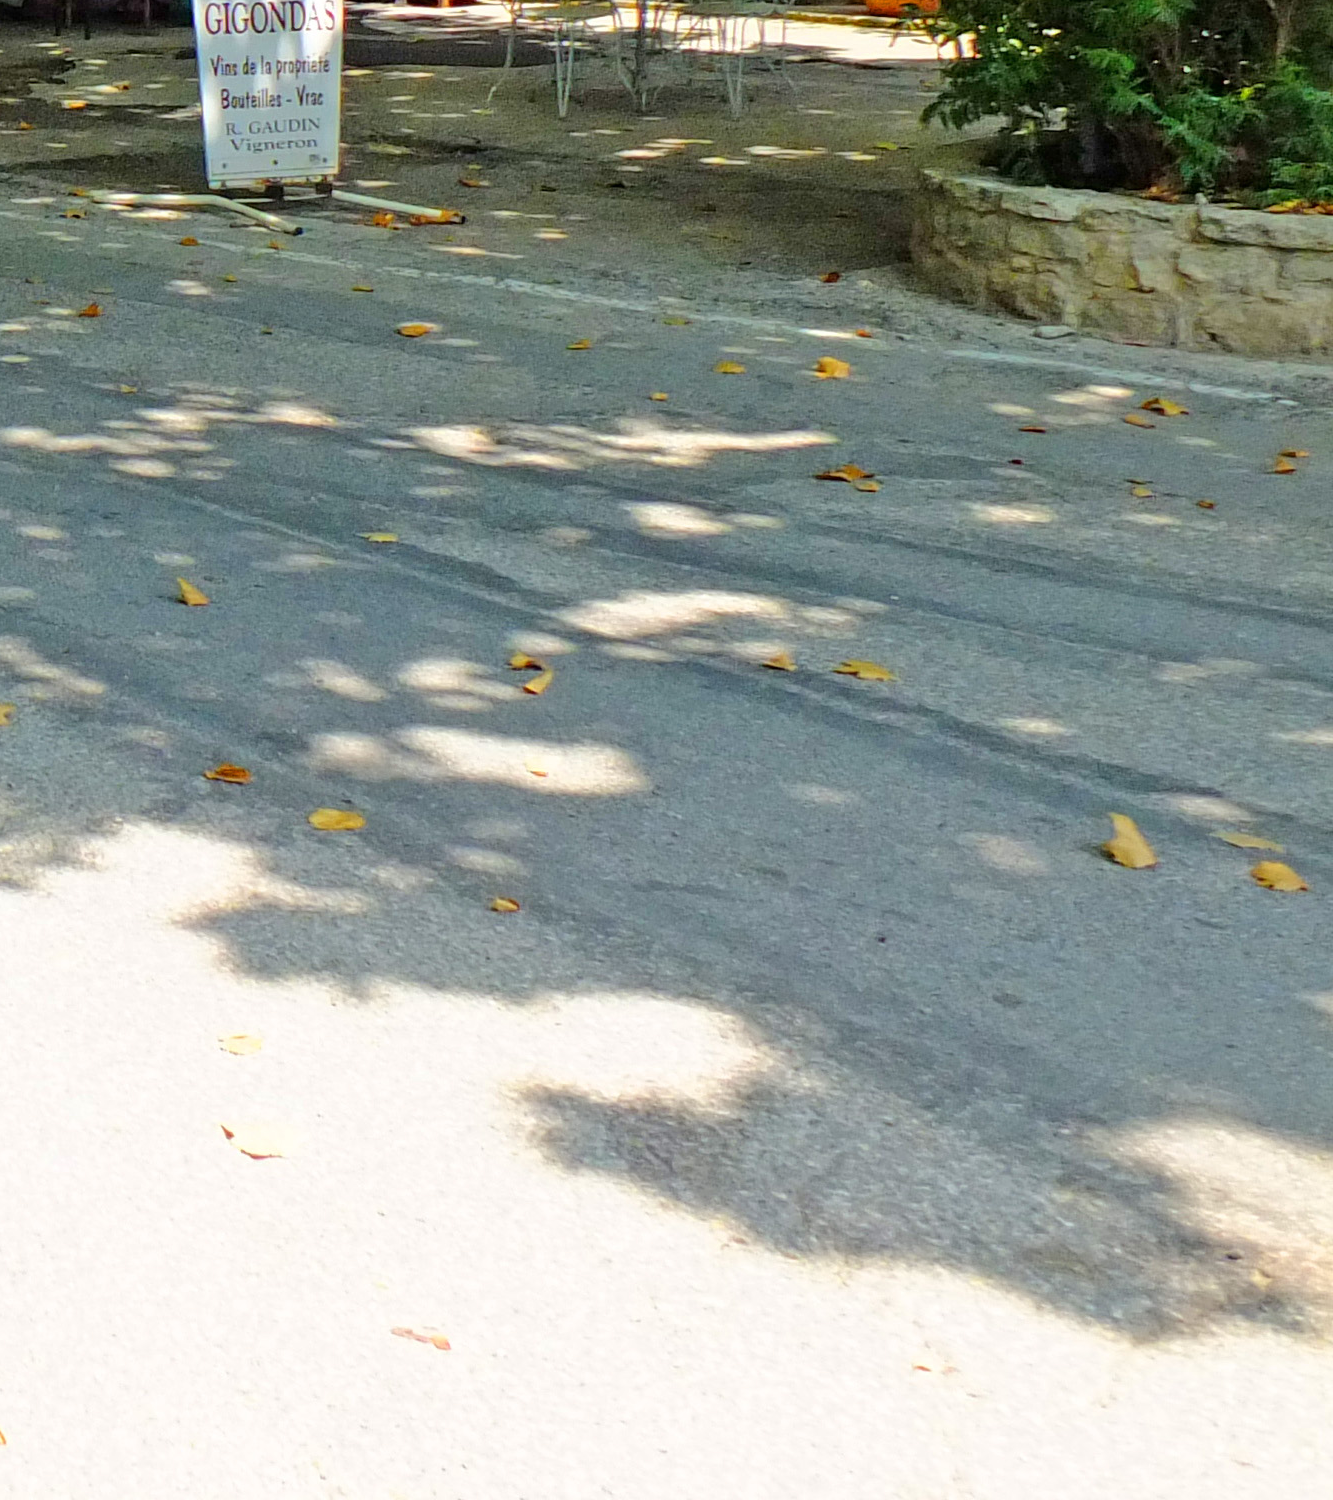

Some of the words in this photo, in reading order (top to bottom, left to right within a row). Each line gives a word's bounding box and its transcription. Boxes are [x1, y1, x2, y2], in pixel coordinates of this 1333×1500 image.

[204, 0, 336, 35] GIGONDAS
[210, 54, 238, 77] Vins
[242, 55, 257, 76] de
[260, 55, 272, 74] la
[276, 52, 331, 80] propriété
[220, 88, 282, 110] Bouteilles
[296, 84, 324, 107] Vrac
[248, 118, 321, 135] GAUDIN
[230, 138, 318, 154] Vigneron
